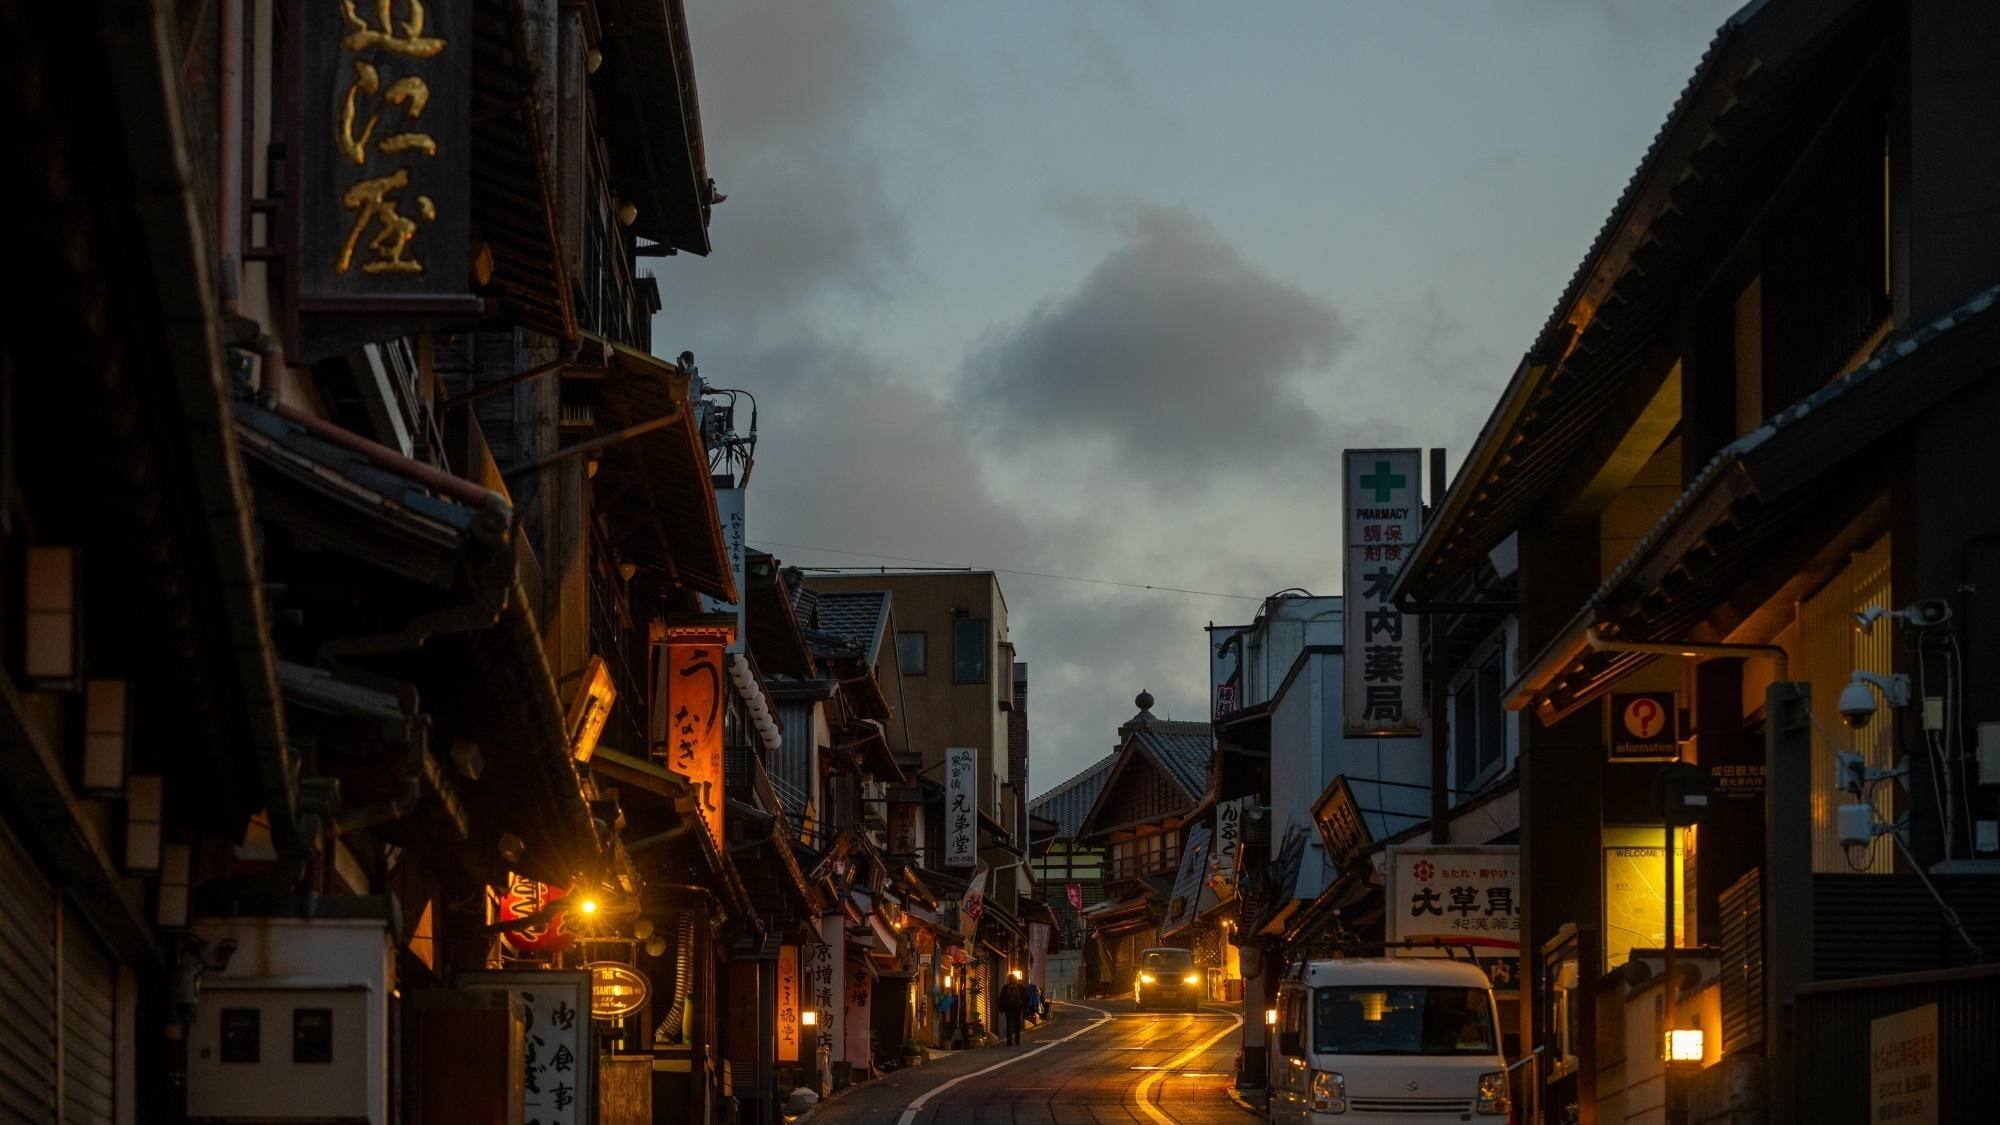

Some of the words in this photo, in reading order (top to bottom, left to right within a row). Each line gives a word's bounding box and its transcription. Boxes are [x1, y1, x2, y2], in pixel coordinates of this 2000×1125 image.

[1357, 508, 1408, 520] PHARMACY
[1362, 566, 1404, 721] 木内薬局
[1616, 743, 1674, 753] information
[951, 794, 971, 854] 兄弟堂
[1616, 849, 1657, 857] WELCOME
[1411, 886, 1520, 917] 大草胃
[549, 1001, 575, 1125] 御食事
